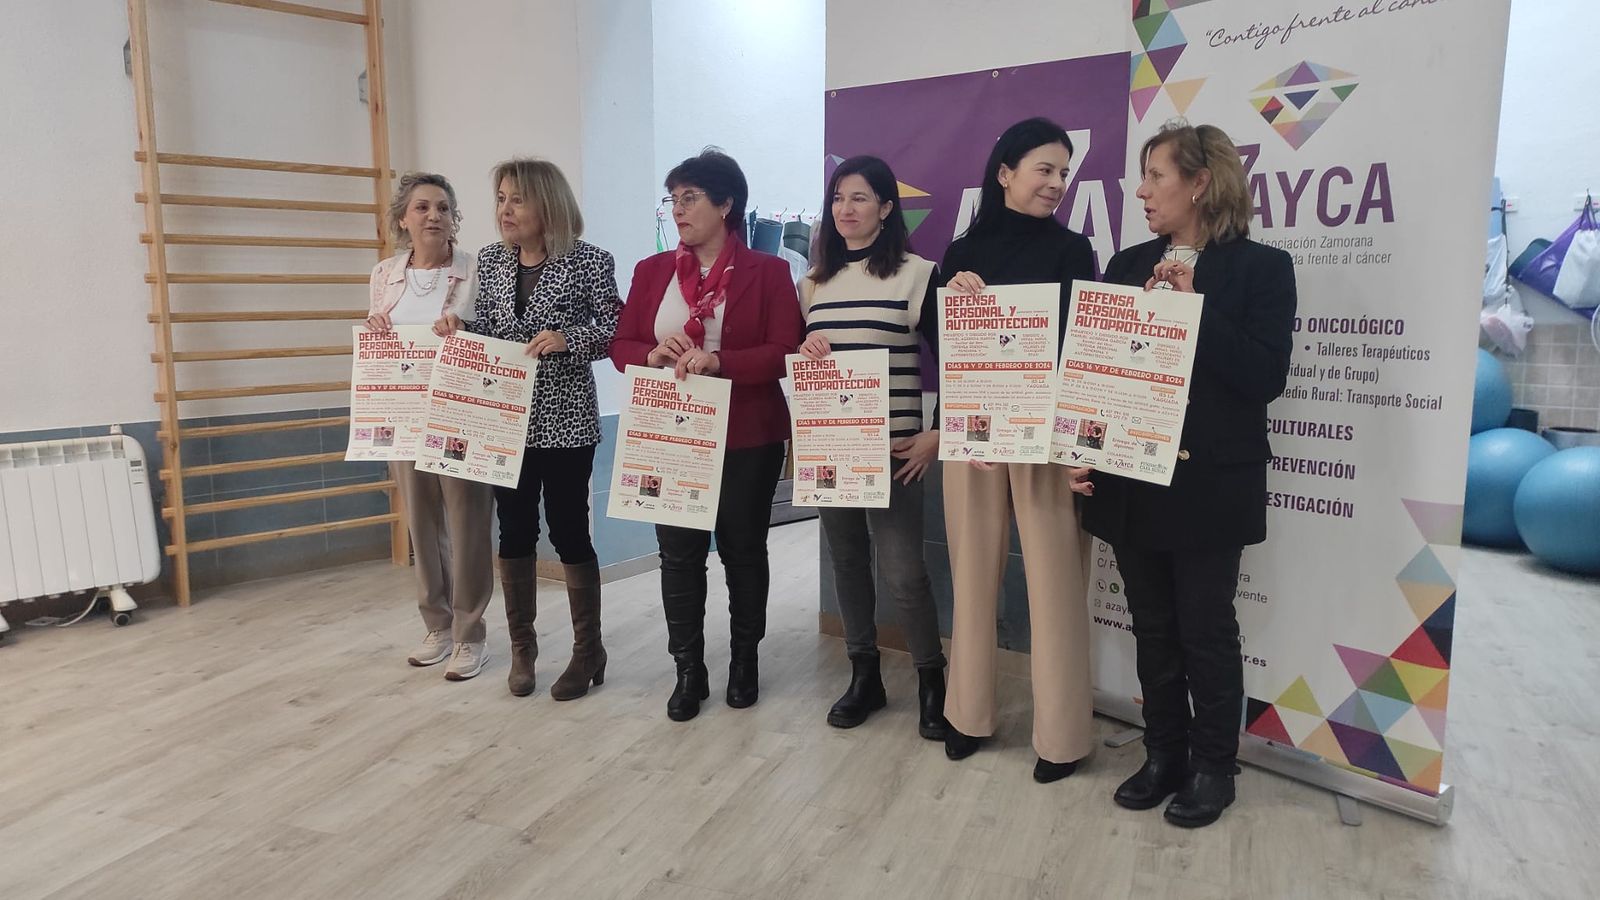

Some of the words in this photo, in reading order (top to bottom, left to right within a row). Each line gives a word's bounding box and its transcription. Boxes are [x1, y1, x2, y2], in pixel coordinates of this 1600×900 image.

[1281, 6, 1357, 45] frente
[1359, 0, 1383, 18] al
[1235, 143, 1395, 229] AYCA
[1320, 235, 1373, 249] Zamorana
[1292, 253, 1304, 265] da
[1307, 252, 1338, 265] frente
[1342, 252, 1351, 264] al
[1355, 252, 1392, 264] cáncer
[945, 294, 996, 307] DEFENSA
[1079, 290, 1135, 308] DEFENSA
[945, 305, 1004, 318] PERSONAL
[1009, 305, 1016, 316] Y
[1077, 302, 1141, 322] PERSONAL
[1147, 310, 1155, 323] Y
[946, 313, 1048, 331] AUTOPROTECCIÓN
[1075, 316, 1188, 341] AUTOPROTECCIÓN
[1293, 317, 1302, 332] O
[1308, 315, 1405, 335] ONCOLÓGICO
[359, 332, 398, 342] DEFENSA
[359, 341, 405, 350] PERSONAL
[409, 341, 415, 350] Y
[445, 335, 484, 351] DEFENSA
[442, 345, 490, 363] PERSONAL
[495, 355, 501, 365] Y
[1317, 342, 1358, 358] Talleres
[1362, 343, 1430, 362] Terapéuticos
[439, 356, 527, 380] AUTOPROTECCIÓN
[792, 359, 836, 371] DEFENSA
[793, 369, 843, 381] PERSONAL
[847, 369, 853, 378] Y
[1121, 368, 1151, 379] FEBRERO
[1154, 373, 1163, 381] DE
[1166, 374, 1183, 384] 2024
[1288, 363, 1316, 378] idual
[1320, 368, 1325, 382] y
[1328, 365, 1340, 379] de
[1345, 366, 1379, 385] Grupo)
[634, 377, 676, 391] DEFENSA
[795, 376, 880, 392] AUTOPROTECCIÓN
[632, 387, 681, 401] PERSONAL
[686, 394, 692, 403] Y
[1312, 386, 1343, 402] Rural:
[1347, 389, 1401, 408] Transporte
[1405, 393, 1442, 411] Social
[631, 396, 716, 416] AUTOPROTECCIÓN
[1266, 491, 1354, 518] ESTIGACIÓN
[1239, 573, 1251, 583] ra
[1237, 590, 1268, 604] vente
[1093, 615, 1132, 632] www.a
[1242, 654, 1267, 667] r.es
